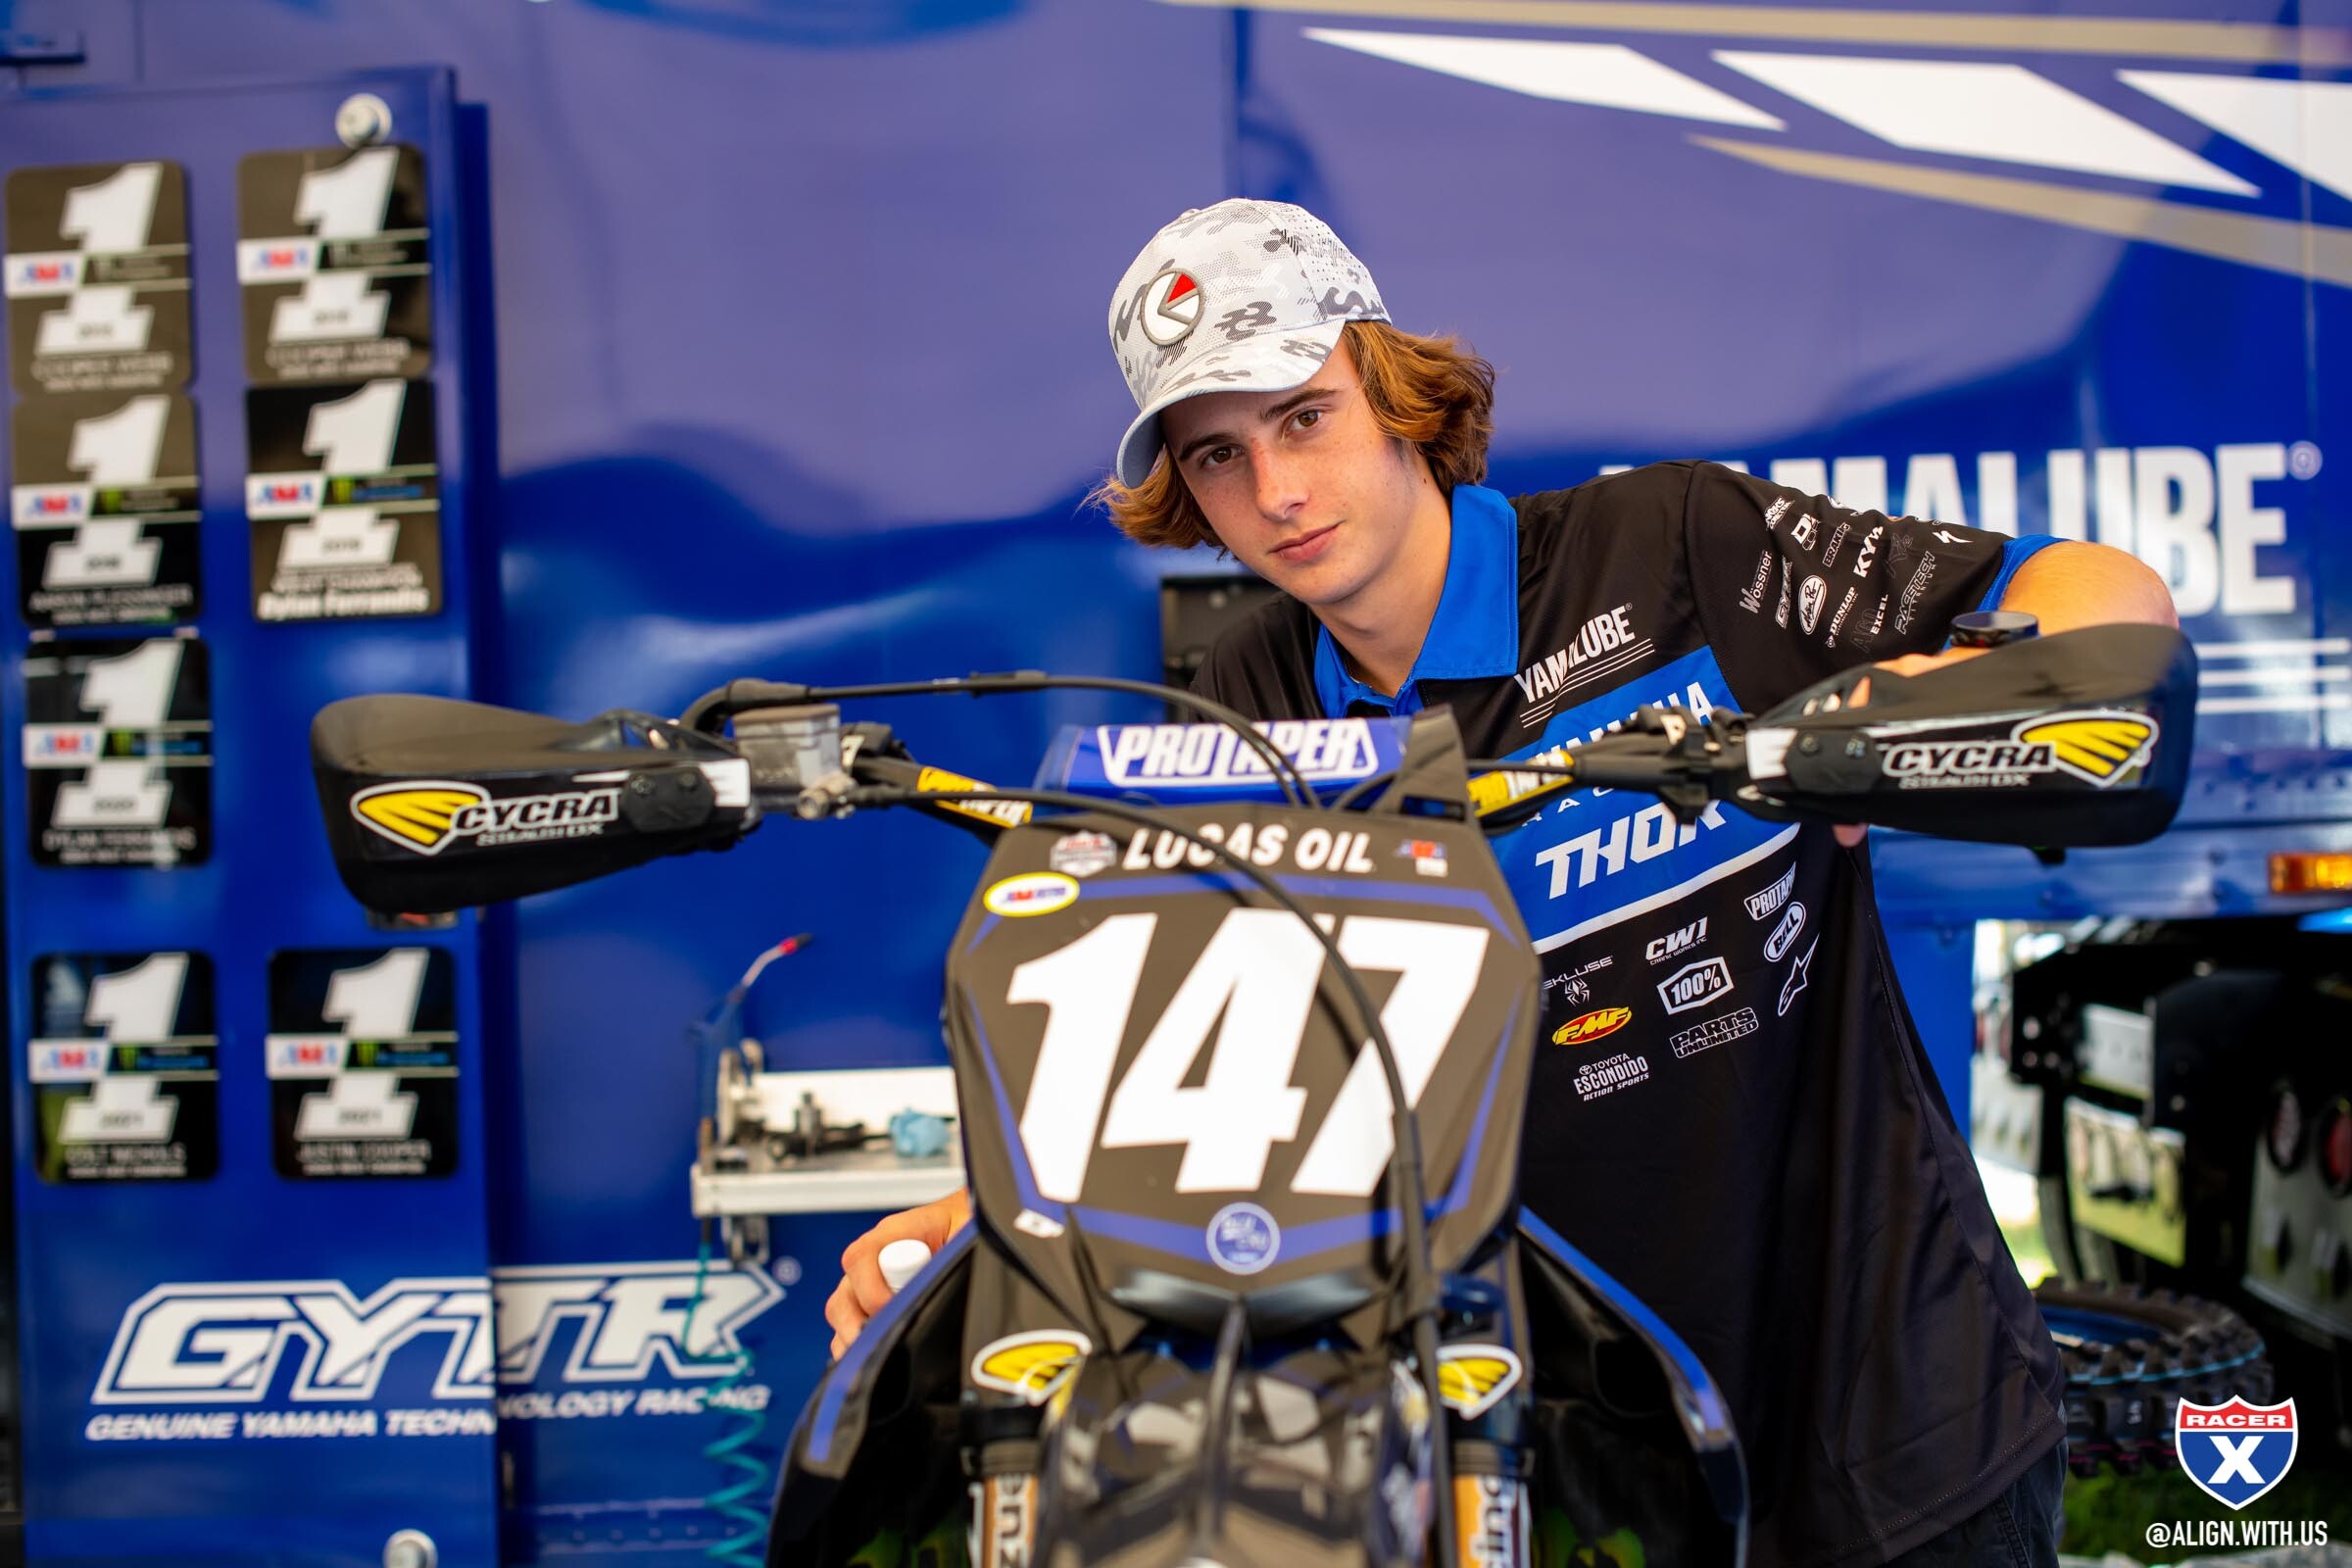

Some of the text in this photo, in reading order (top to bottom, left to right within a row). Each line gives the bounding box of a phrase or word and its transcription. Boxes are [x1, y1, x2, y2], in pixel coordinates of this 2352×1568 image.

[34, 162, 162, 356] 1
[42, 395, 171, 588] 1
[277, 378, 407, 565] 1
[1823, 521, 1851, 568] BRAKIG
[1739, 550, 1773, 614] Wössner
[1893, 550, 1936, 636] RACETECH
[1829, 586, 1856, 636] DUNLOP
[1869, 593, 1889, 636] EXCEL
[1107, 719, 1375, 784] PROTAPER
[1883, 741, 2057, 777] CYCRA
[453, 790, 617, 834] CYCRA
[1123, 824, 1289, 870] LUCAS
[1295, 827, 1374, 873] OIL
[1544, 955, 1613, 990] EKLUSE
[1670, 964, 1721, 1006] 100%
[59, 953, 188, 1144] 1
[295, 948, 429, 1142] 1
[1554, 1005, 1631, 1046] FMF
[1670, 1007, 1756, 1051] PARTS
[1675, 1019, 1759, 1058] UNLIMITED
[1006, 906, 1490, 1203] 147
[1573, 1054, 1649, 1095] ESCONDIDO
[1592, 1053, 1630, 1072] TOYOTA
[1583, 1072, 1650, 1102] ACTION SPORTS
[92, 1261, 784, 1404] GYTR
[85, 1412, 237, 1442] GENUINE
[241, 1410, 376, 1440] YAMAHA
